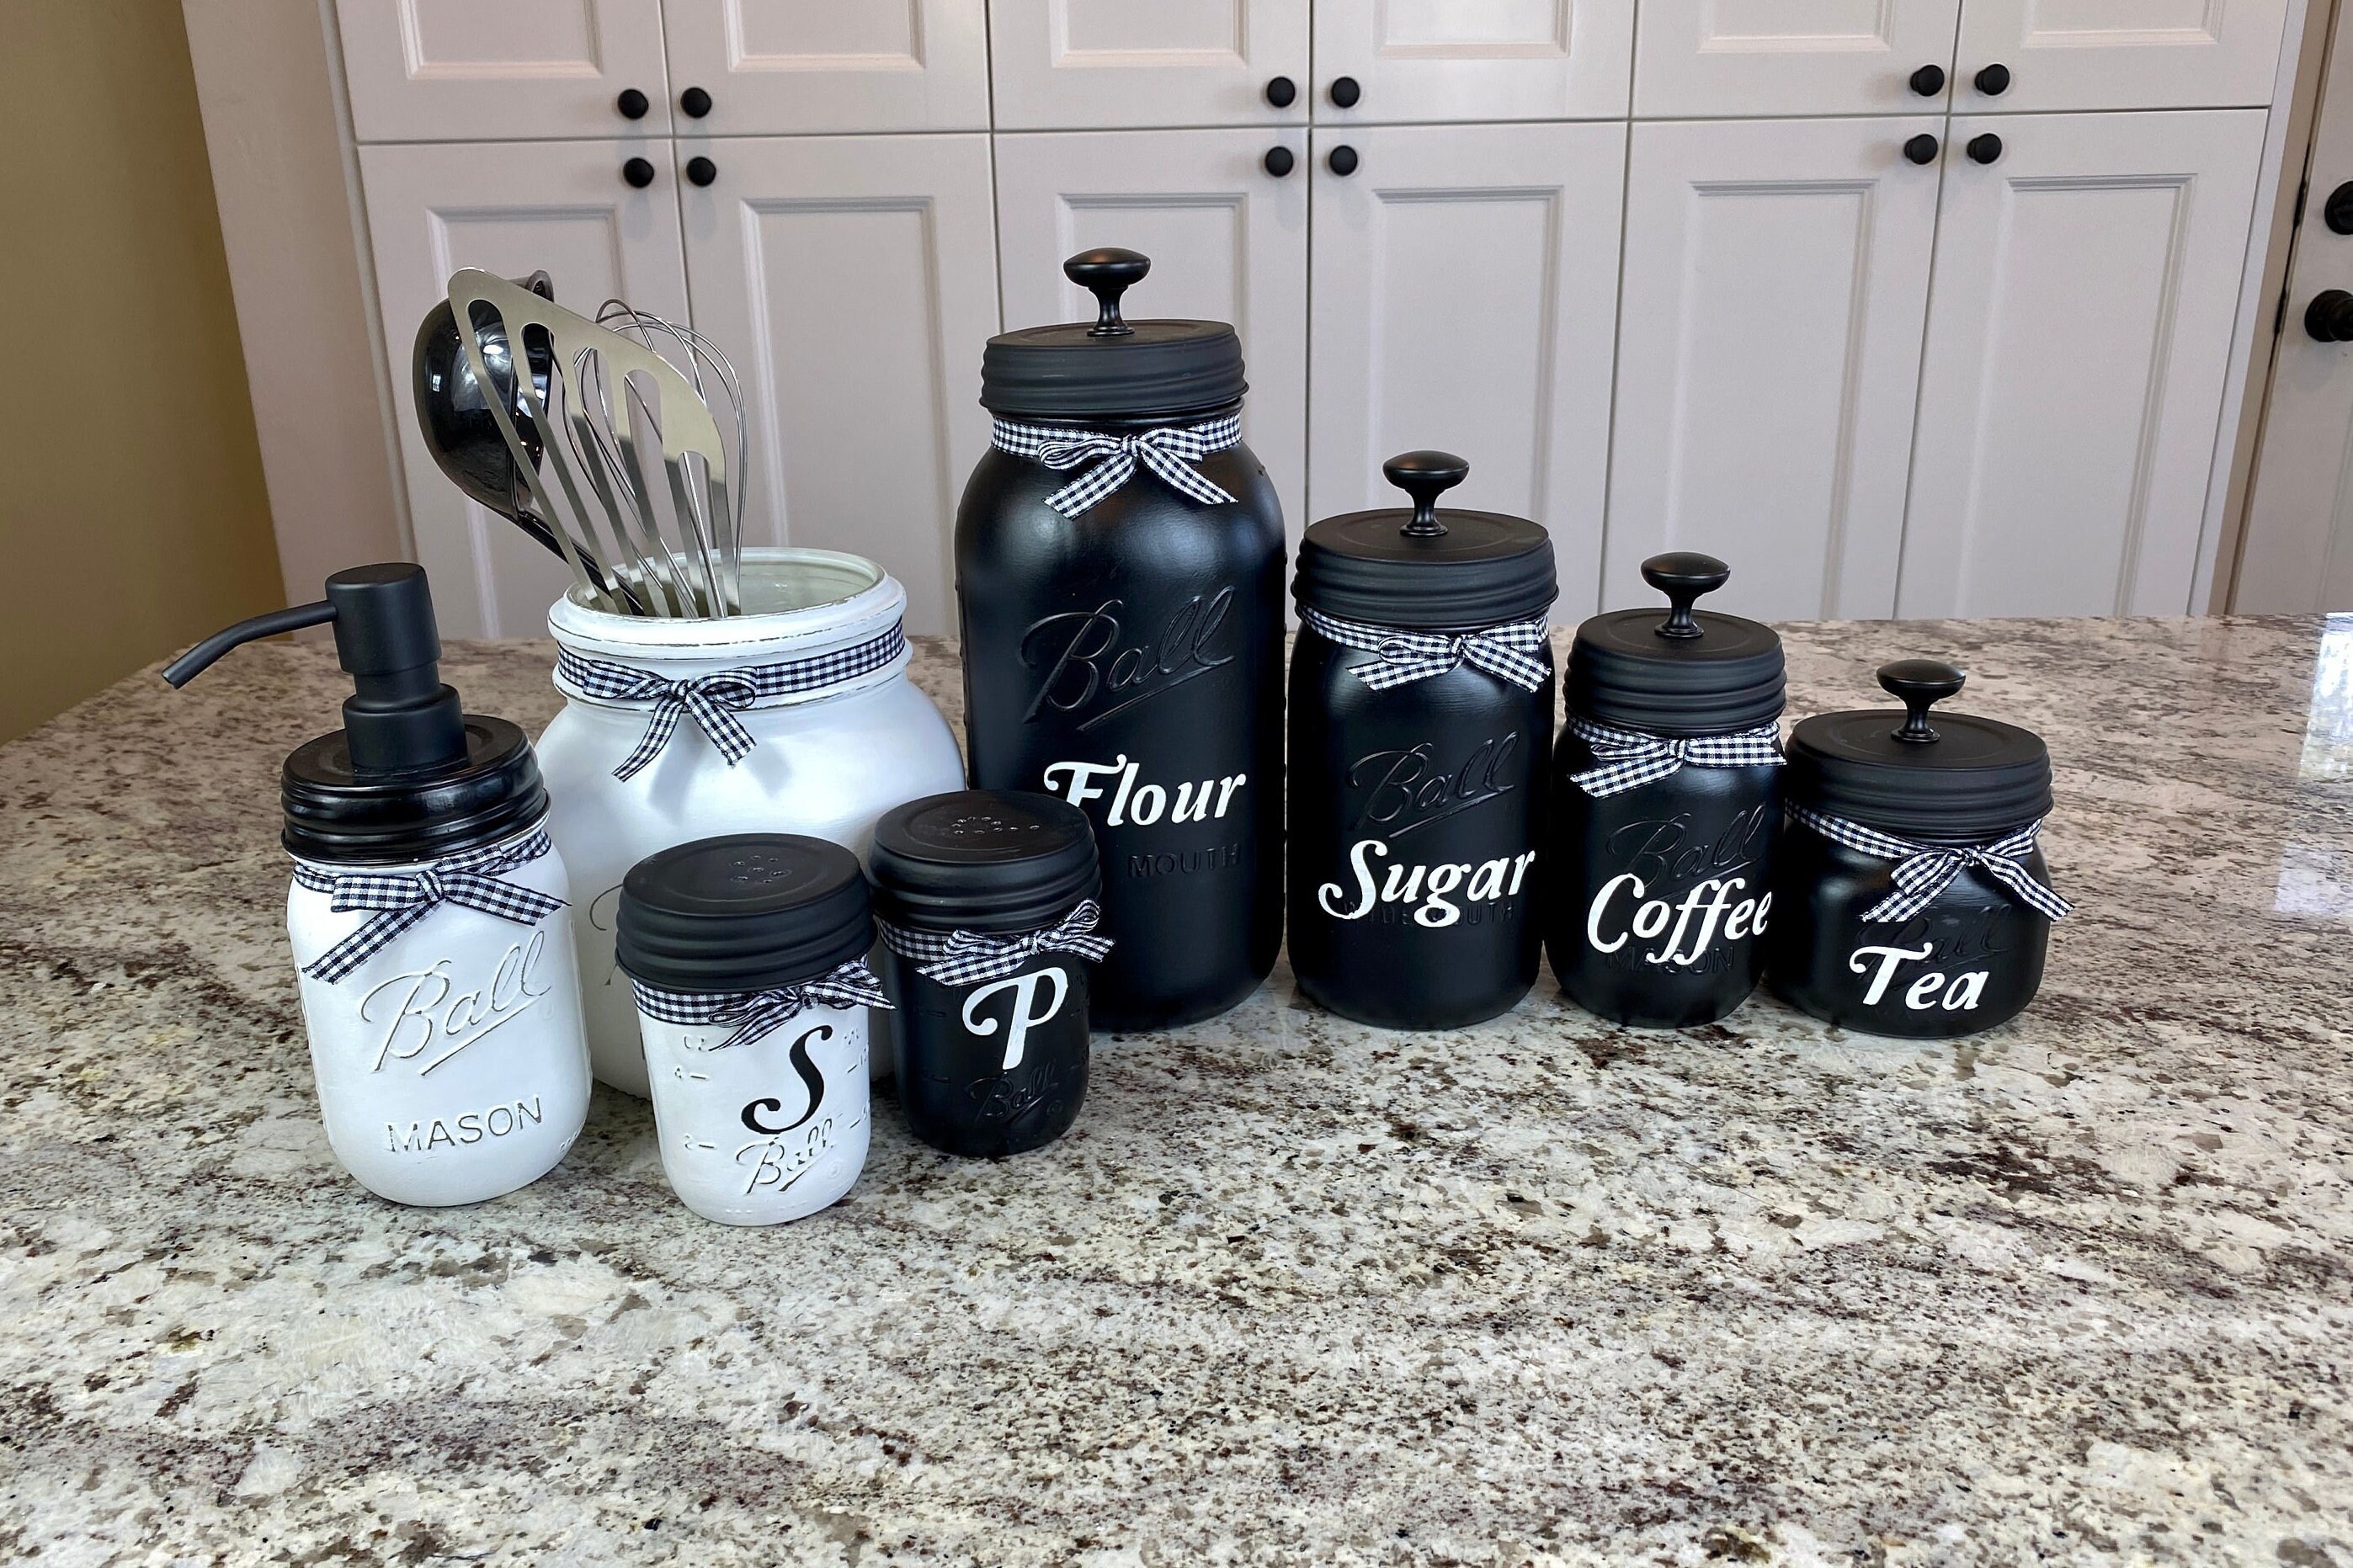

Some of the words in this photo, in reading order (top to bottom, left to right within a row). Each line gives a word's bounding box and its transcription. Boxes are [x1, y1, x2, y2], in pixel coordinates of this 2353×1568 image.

[1019, 585, 1236, 731] Ball
[1043, 753, 1247, 827] Flour
[1348, 731, 1520, 838] Ball
[1127, 842, 1241, 879] MOUTH
[1318, 839, 1536, 928] Sugar
[1587, 872, 1773, 966] Coffee
[357, 930, 551, 1076] Ball
[961, 966, 1069, 1071] P
[1849, 941, 1990, 1011] Tea
[385, 1096, 543, 1152] MASON
[740, 1024, 833, 1135] S
